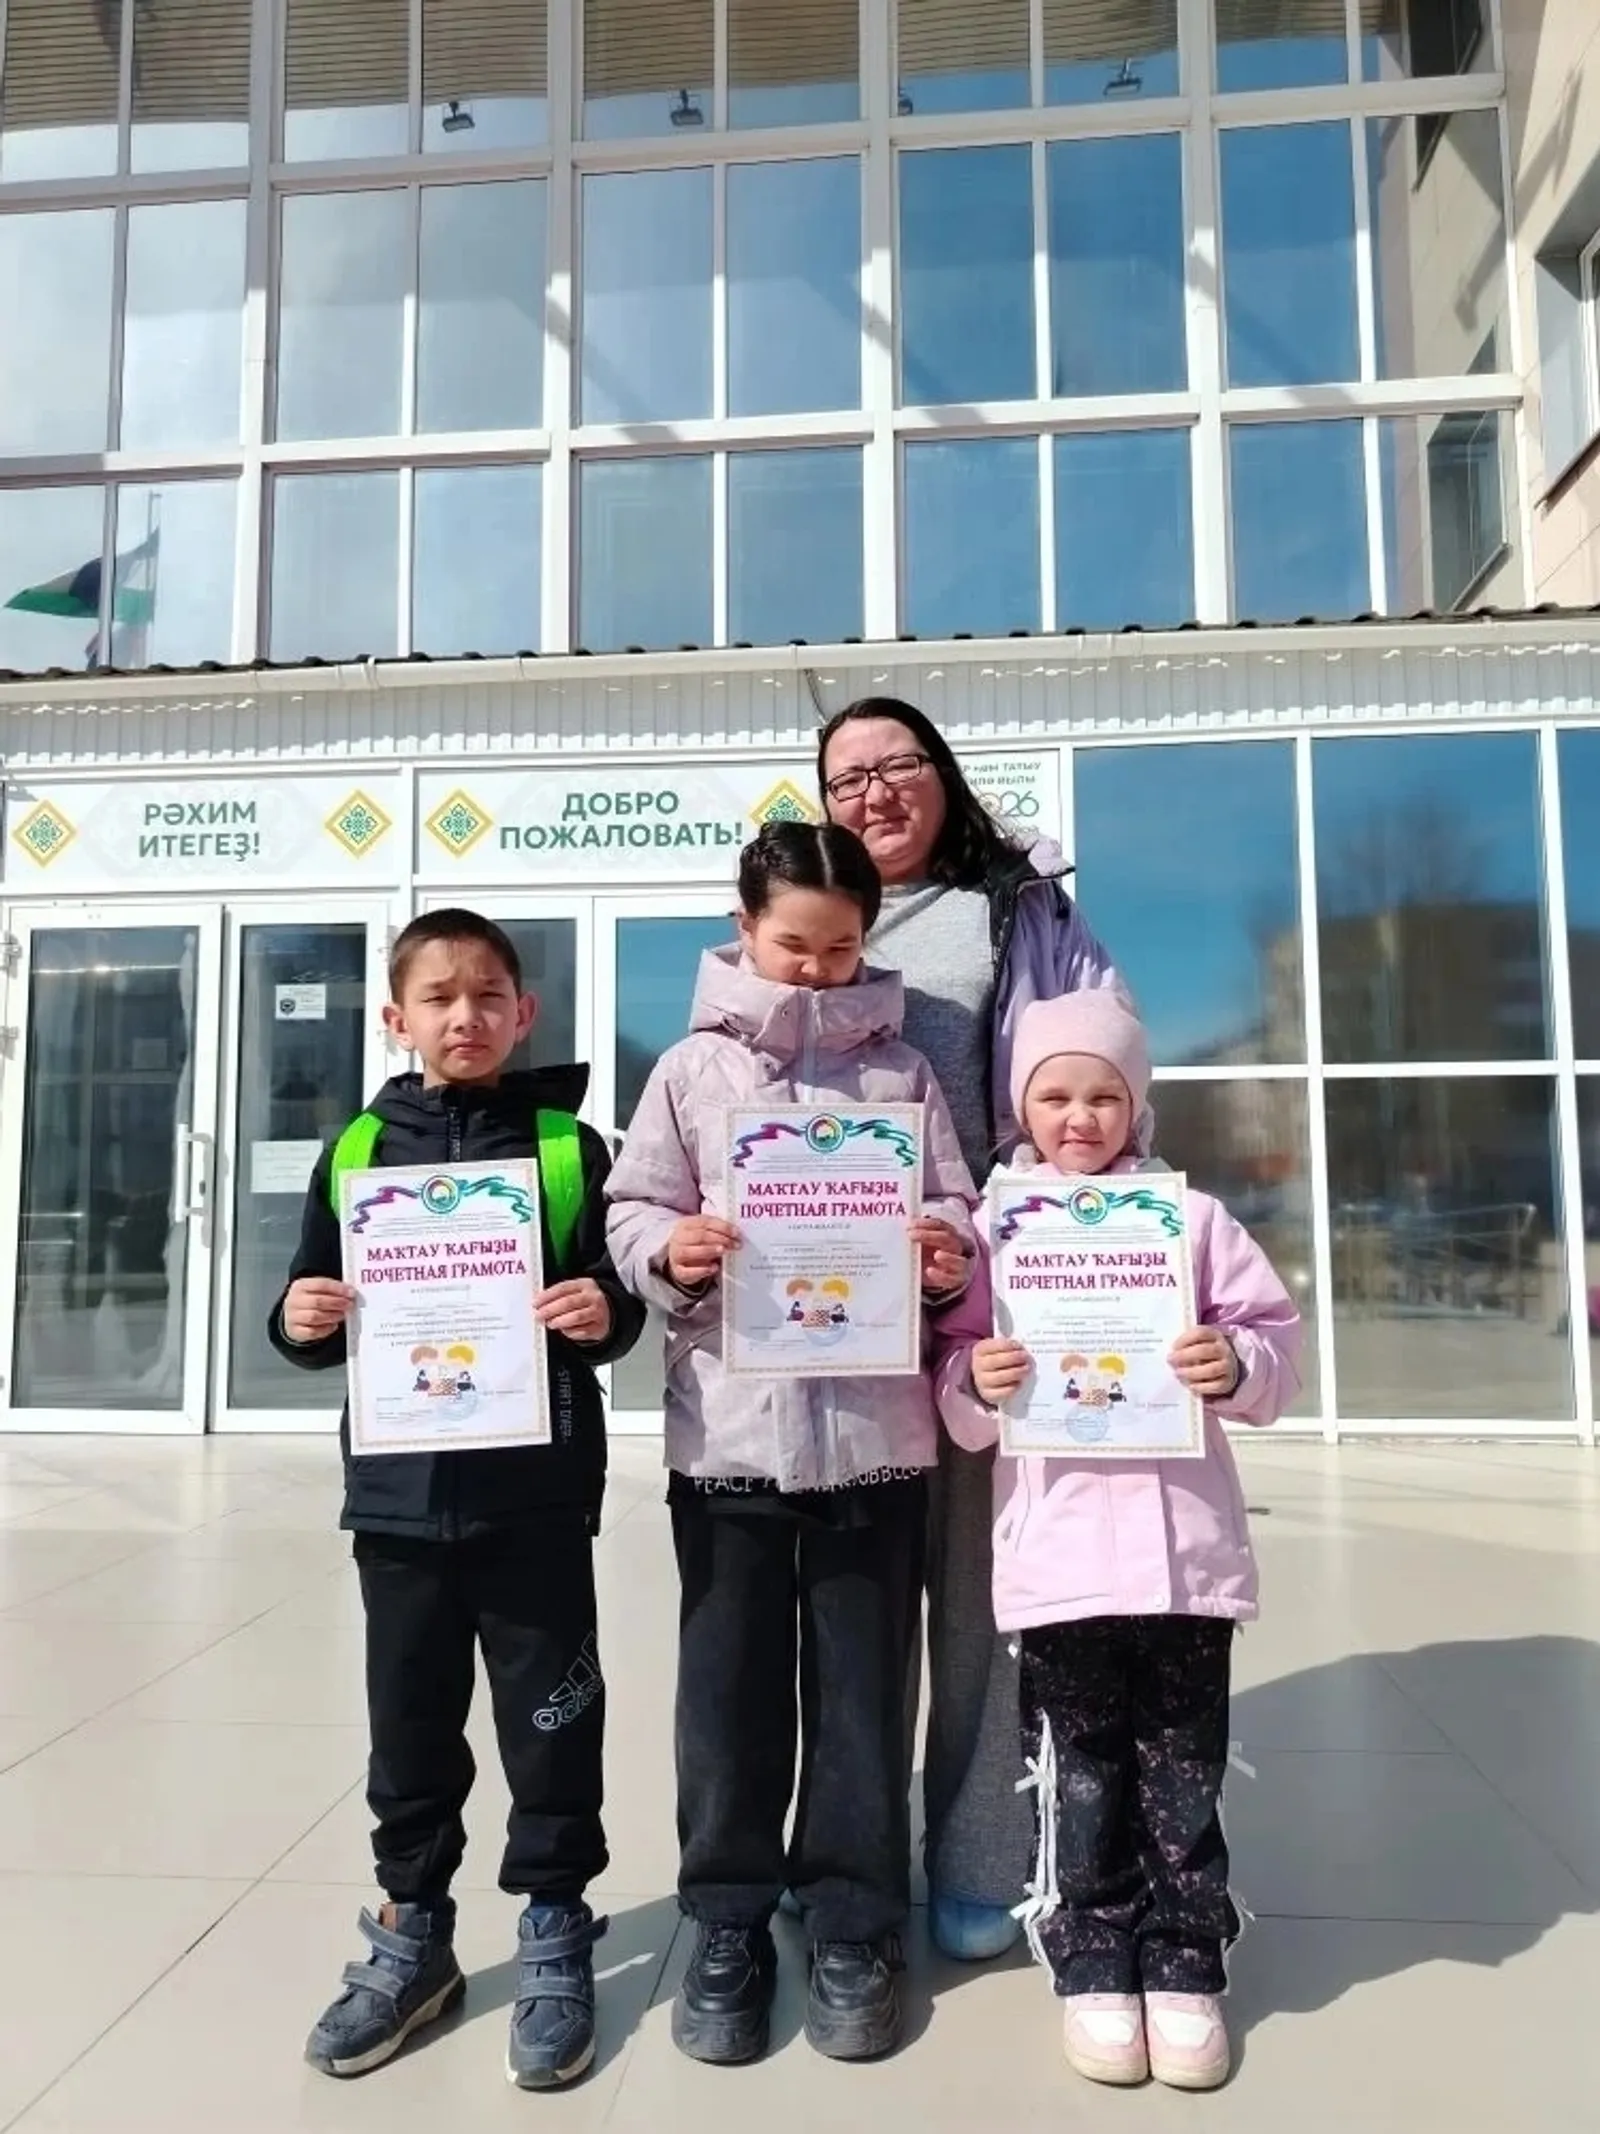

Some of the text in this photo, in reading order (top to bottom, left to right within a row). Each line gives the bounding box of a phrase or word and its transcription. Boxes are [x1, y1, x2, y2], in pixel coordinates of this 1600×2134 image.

[144, 801, 257, 826] РӘХИМ
[562, 790, 680, 821] ДОБРО
[139, 832, 260, 862] ИТЕГЕҘ!
[500, 822, 743, 850] ПОЖАЛОВАТЬ!
[741, 1200, 907, 1219] ПОЧЕТНАЯ ГРАМОТА
[361, 1260, 527, 1284] ПОЧЕТНАЯ ГРАМОТА
[1009, 1272, 1178, 1290] ПОЧЕТНАЯ ГРАМОТА
